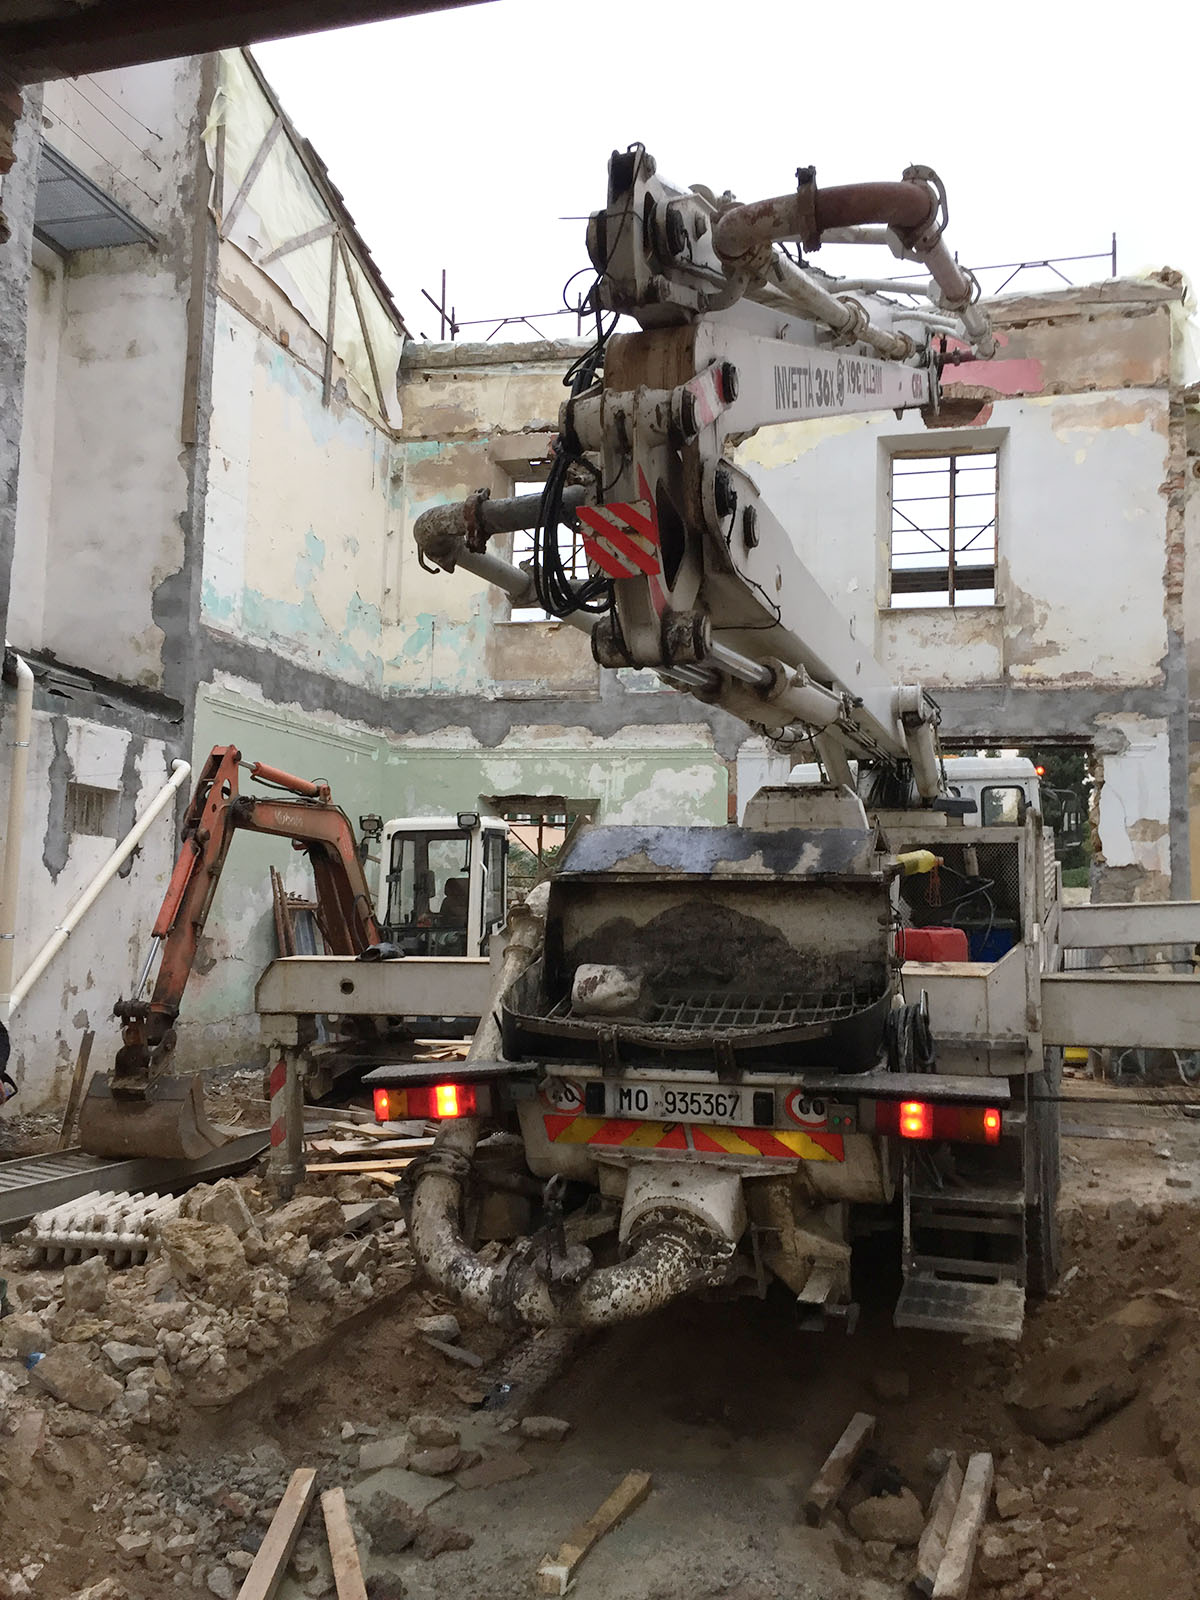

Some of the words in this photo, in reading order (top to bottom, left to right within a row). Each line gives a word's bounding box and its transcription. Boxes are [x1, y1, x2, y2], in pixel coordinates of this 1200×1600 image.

[815, 367, 835, 407] 36X
[619, 1089, 648, 1112] MO
[664, 1091, 740, 1117] 935367
